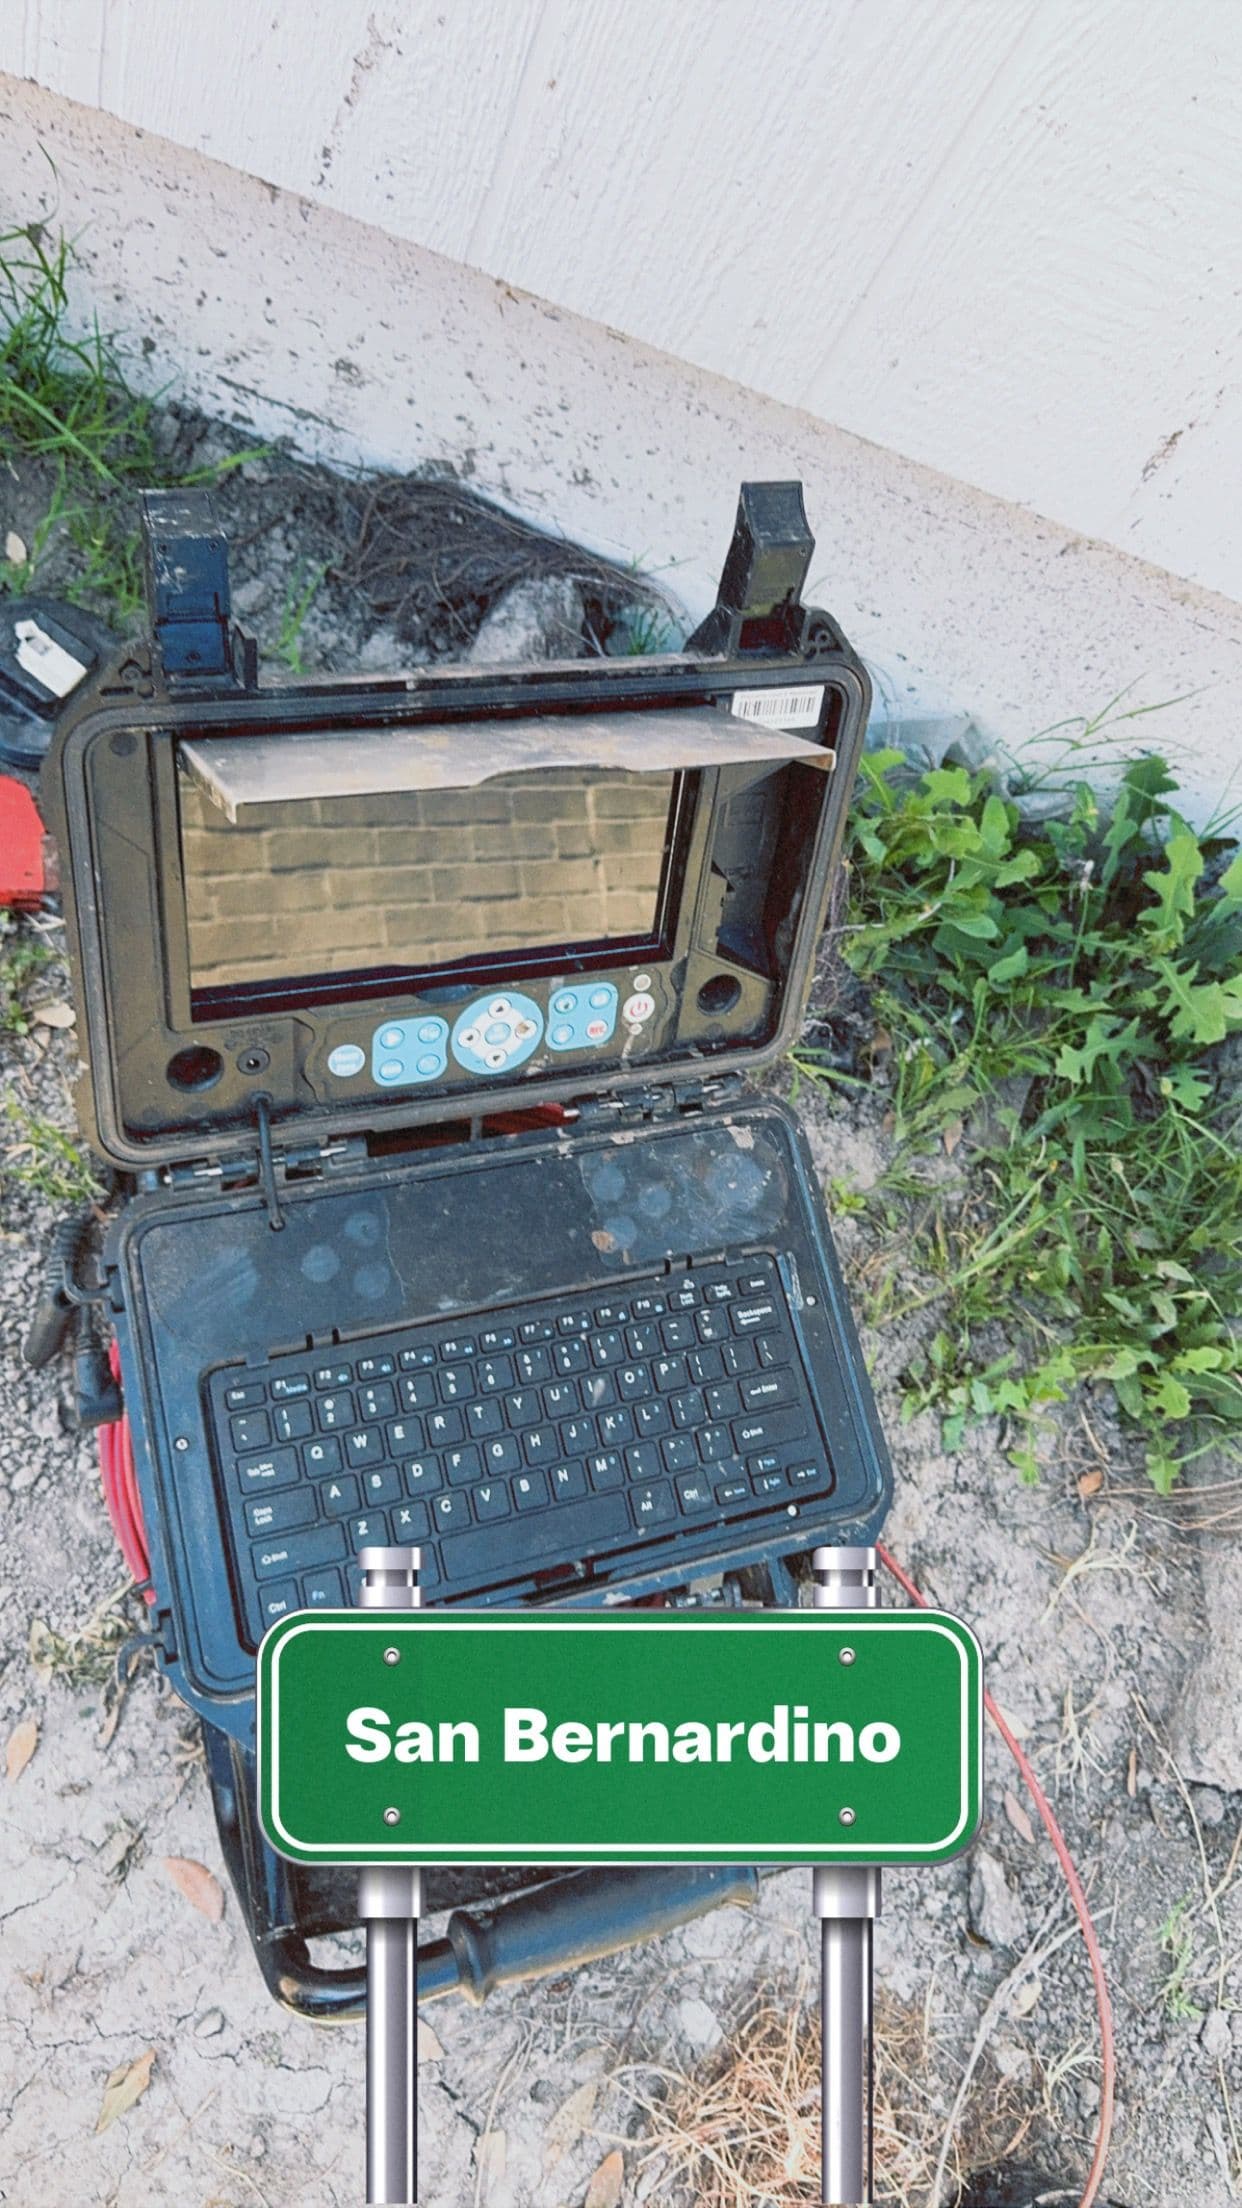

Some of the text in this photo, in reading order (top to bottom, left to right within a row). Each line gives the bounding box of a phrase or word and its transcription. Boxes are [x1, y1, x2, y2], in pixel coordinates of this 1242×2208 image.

[404, 1351, 416, 1361] F4
[362, 1360, 374, 1370] F3
[659, 1362, 669, 1375] P
[319, 1370, 331, 1380] F2
[624, 1371, 635, 1384] O
[275, 1380, 286, 1390] F1
[550, 1388, 561, 1401] U
[512, 1396, 522, 1410] Y
[473, 1406, 483, 1419] T
[641, 1407, 651, 1421] L
[434, 1415, 446, 1430] R
[605, 1416, 616, 1429] K
[394, 1425, 405, 1439] E
[569, 1424, 577, 1438] J
[352, 1434, 367, 1448] W
[530, 1433, 541, 1447] H
[311, 1445, 324, 1460] Q
[492, 1443, 504, 1457] G
[452, 1453, 461, 1467] F
[595, 1457, 608, 1472] M
[411, 1463, 423, 1478] D
[557, 1468, 569, 1483] N
[371, 1473, 382, 1488] S
[519, 1478, 530, 1492] B
[329, 1484, 341, 1499] A
[480, 1488, 491, 1502] V
[683, 1488, 699, 1501] Ctrl
[440, 1499, 452, 1513] C
[400, 1509, 412, 1524] X
[357, 1520, 369, 1535] Z
[312, 1590, 326, 1600] Fn
[267, 1600, 287, 1614] Ctrl
